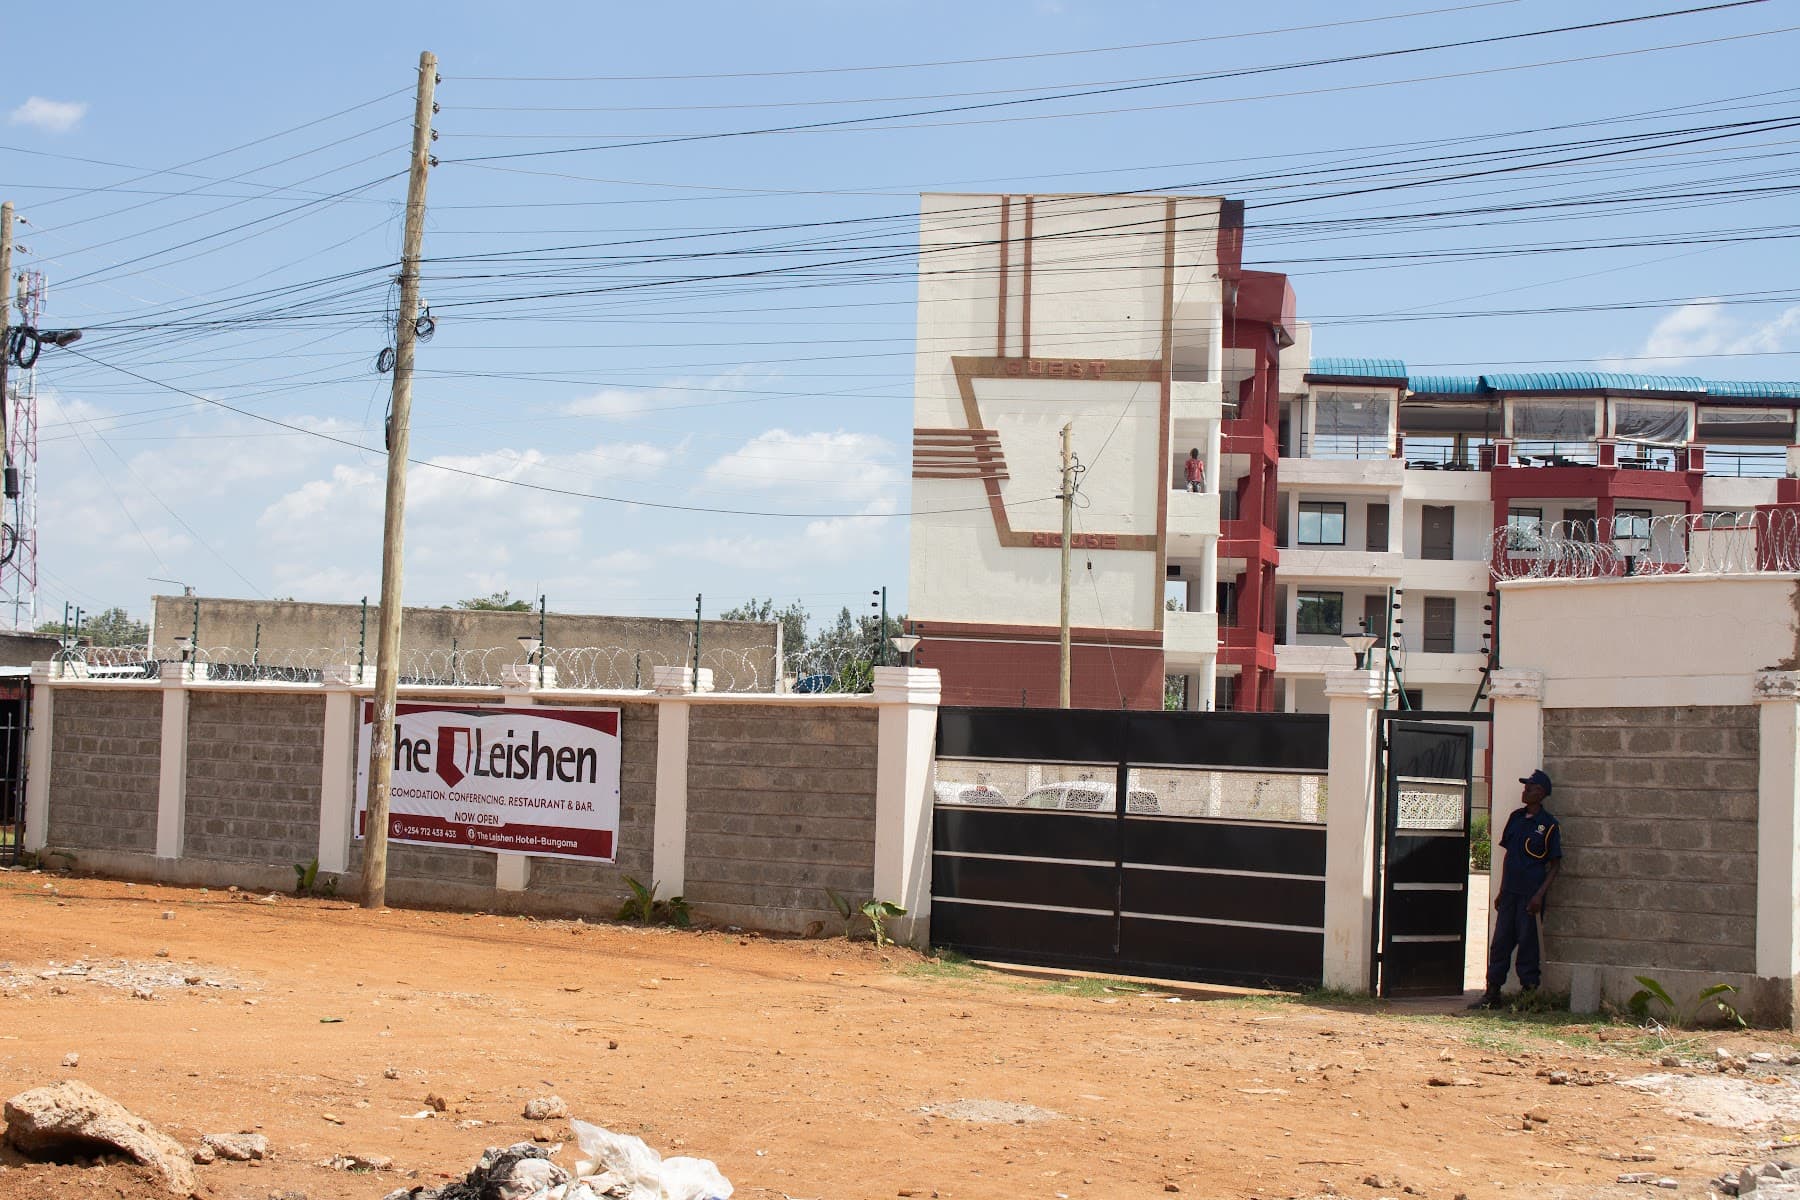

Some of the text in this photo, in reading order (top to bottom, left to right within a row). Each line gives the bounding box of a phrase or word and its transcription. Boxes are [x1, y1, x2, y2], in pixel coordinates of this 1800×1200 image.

[1006, 360, 1106, 379] GUEST
[1032, 532, 1118, 550] HOUSE
[394, 724, 597, 784] he Leishen
[389, 787, 595, 812] COMODATION. CONFERENCING. RESTAURANT & BAR.
[454, 811, 499, 825] NOW OPEN
[403, 825, 419, 835] +254
[420, 827, 431, 836] 712
[476, 831, 489, 841] The
[515, 834, 578, 849] Hotel-Bungoma
